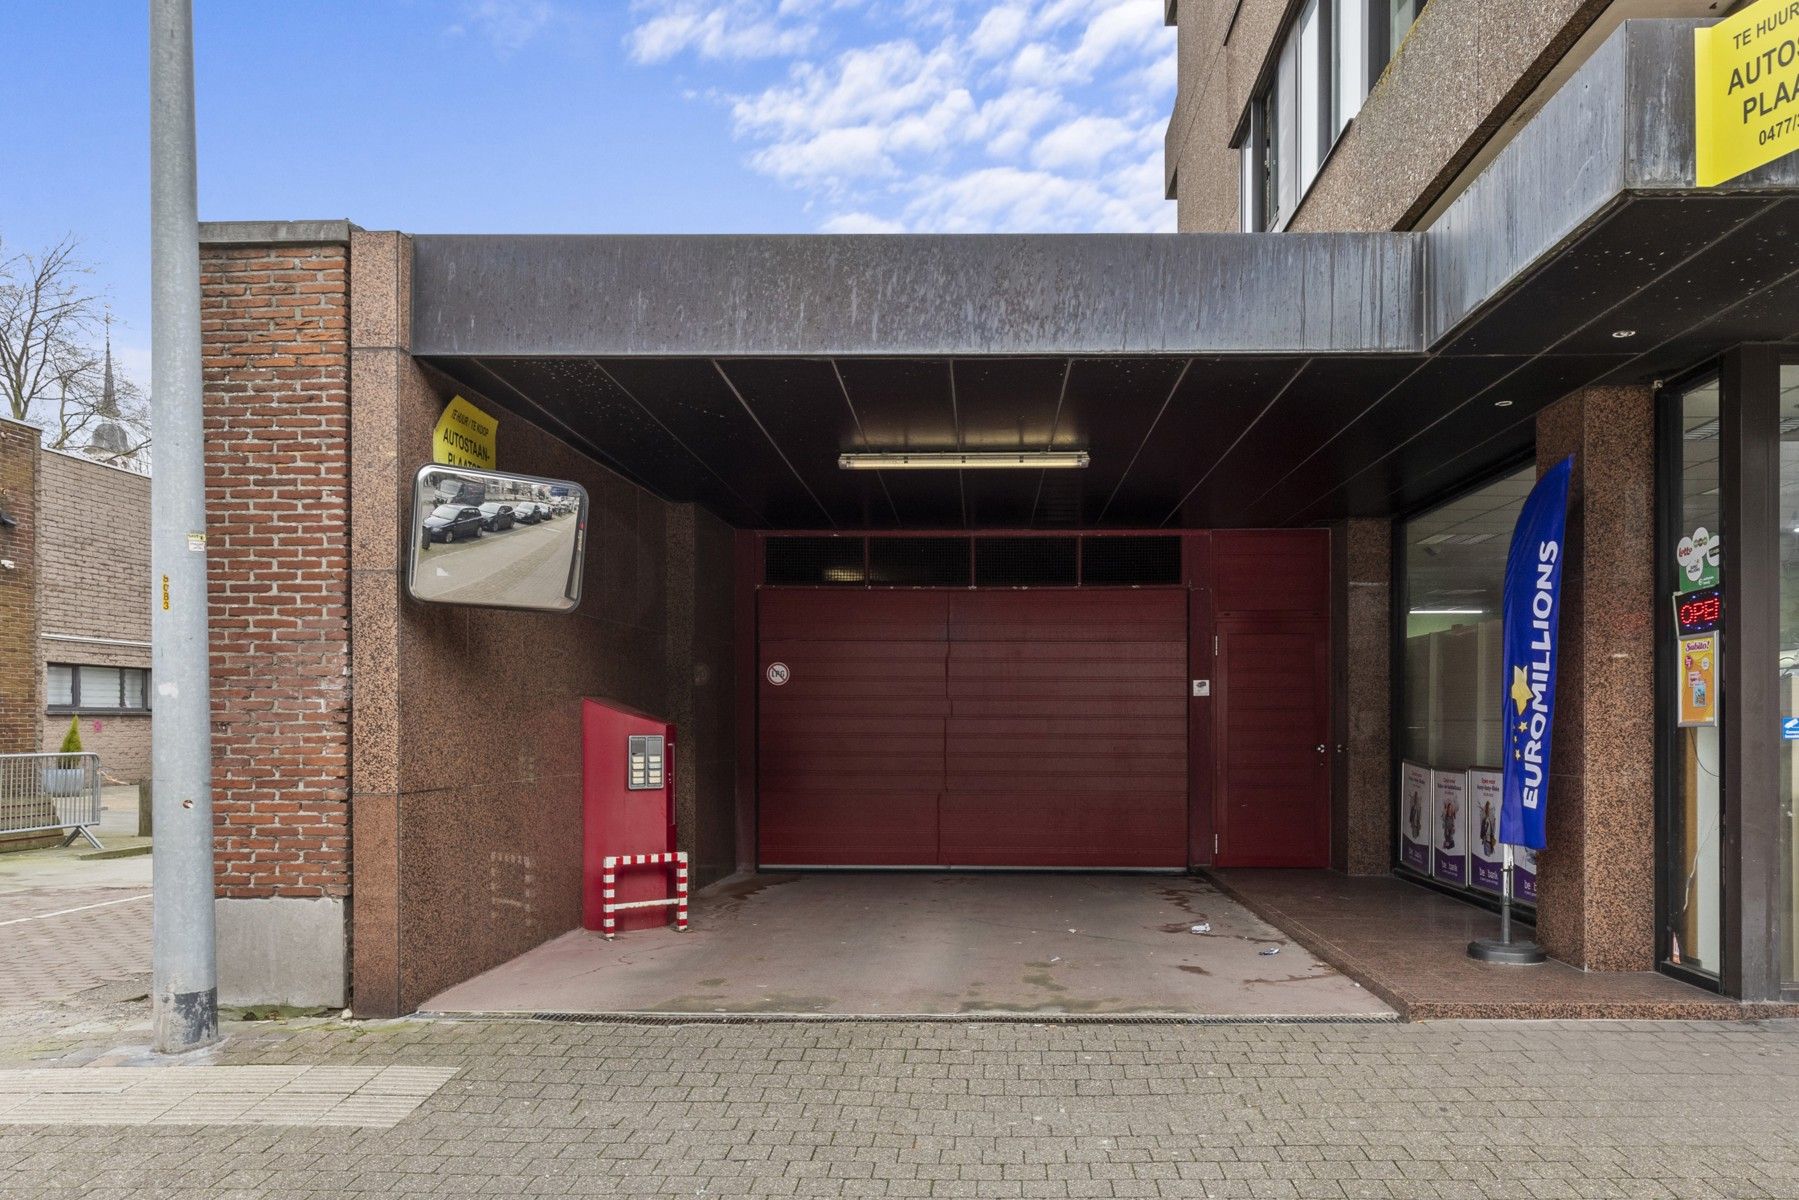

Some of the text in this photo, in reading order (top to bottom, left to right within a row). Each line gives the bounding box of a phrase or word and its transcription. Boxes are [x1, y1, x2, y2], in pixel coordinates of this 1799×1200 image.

[1733, 2, 1799, 49] TE HUUR
[1727, 37, 1799, 96] AUTO
[1759, 114, 1799, 146] 0477/
[1523, 540, 1559, 810] EUROMILLIONS
